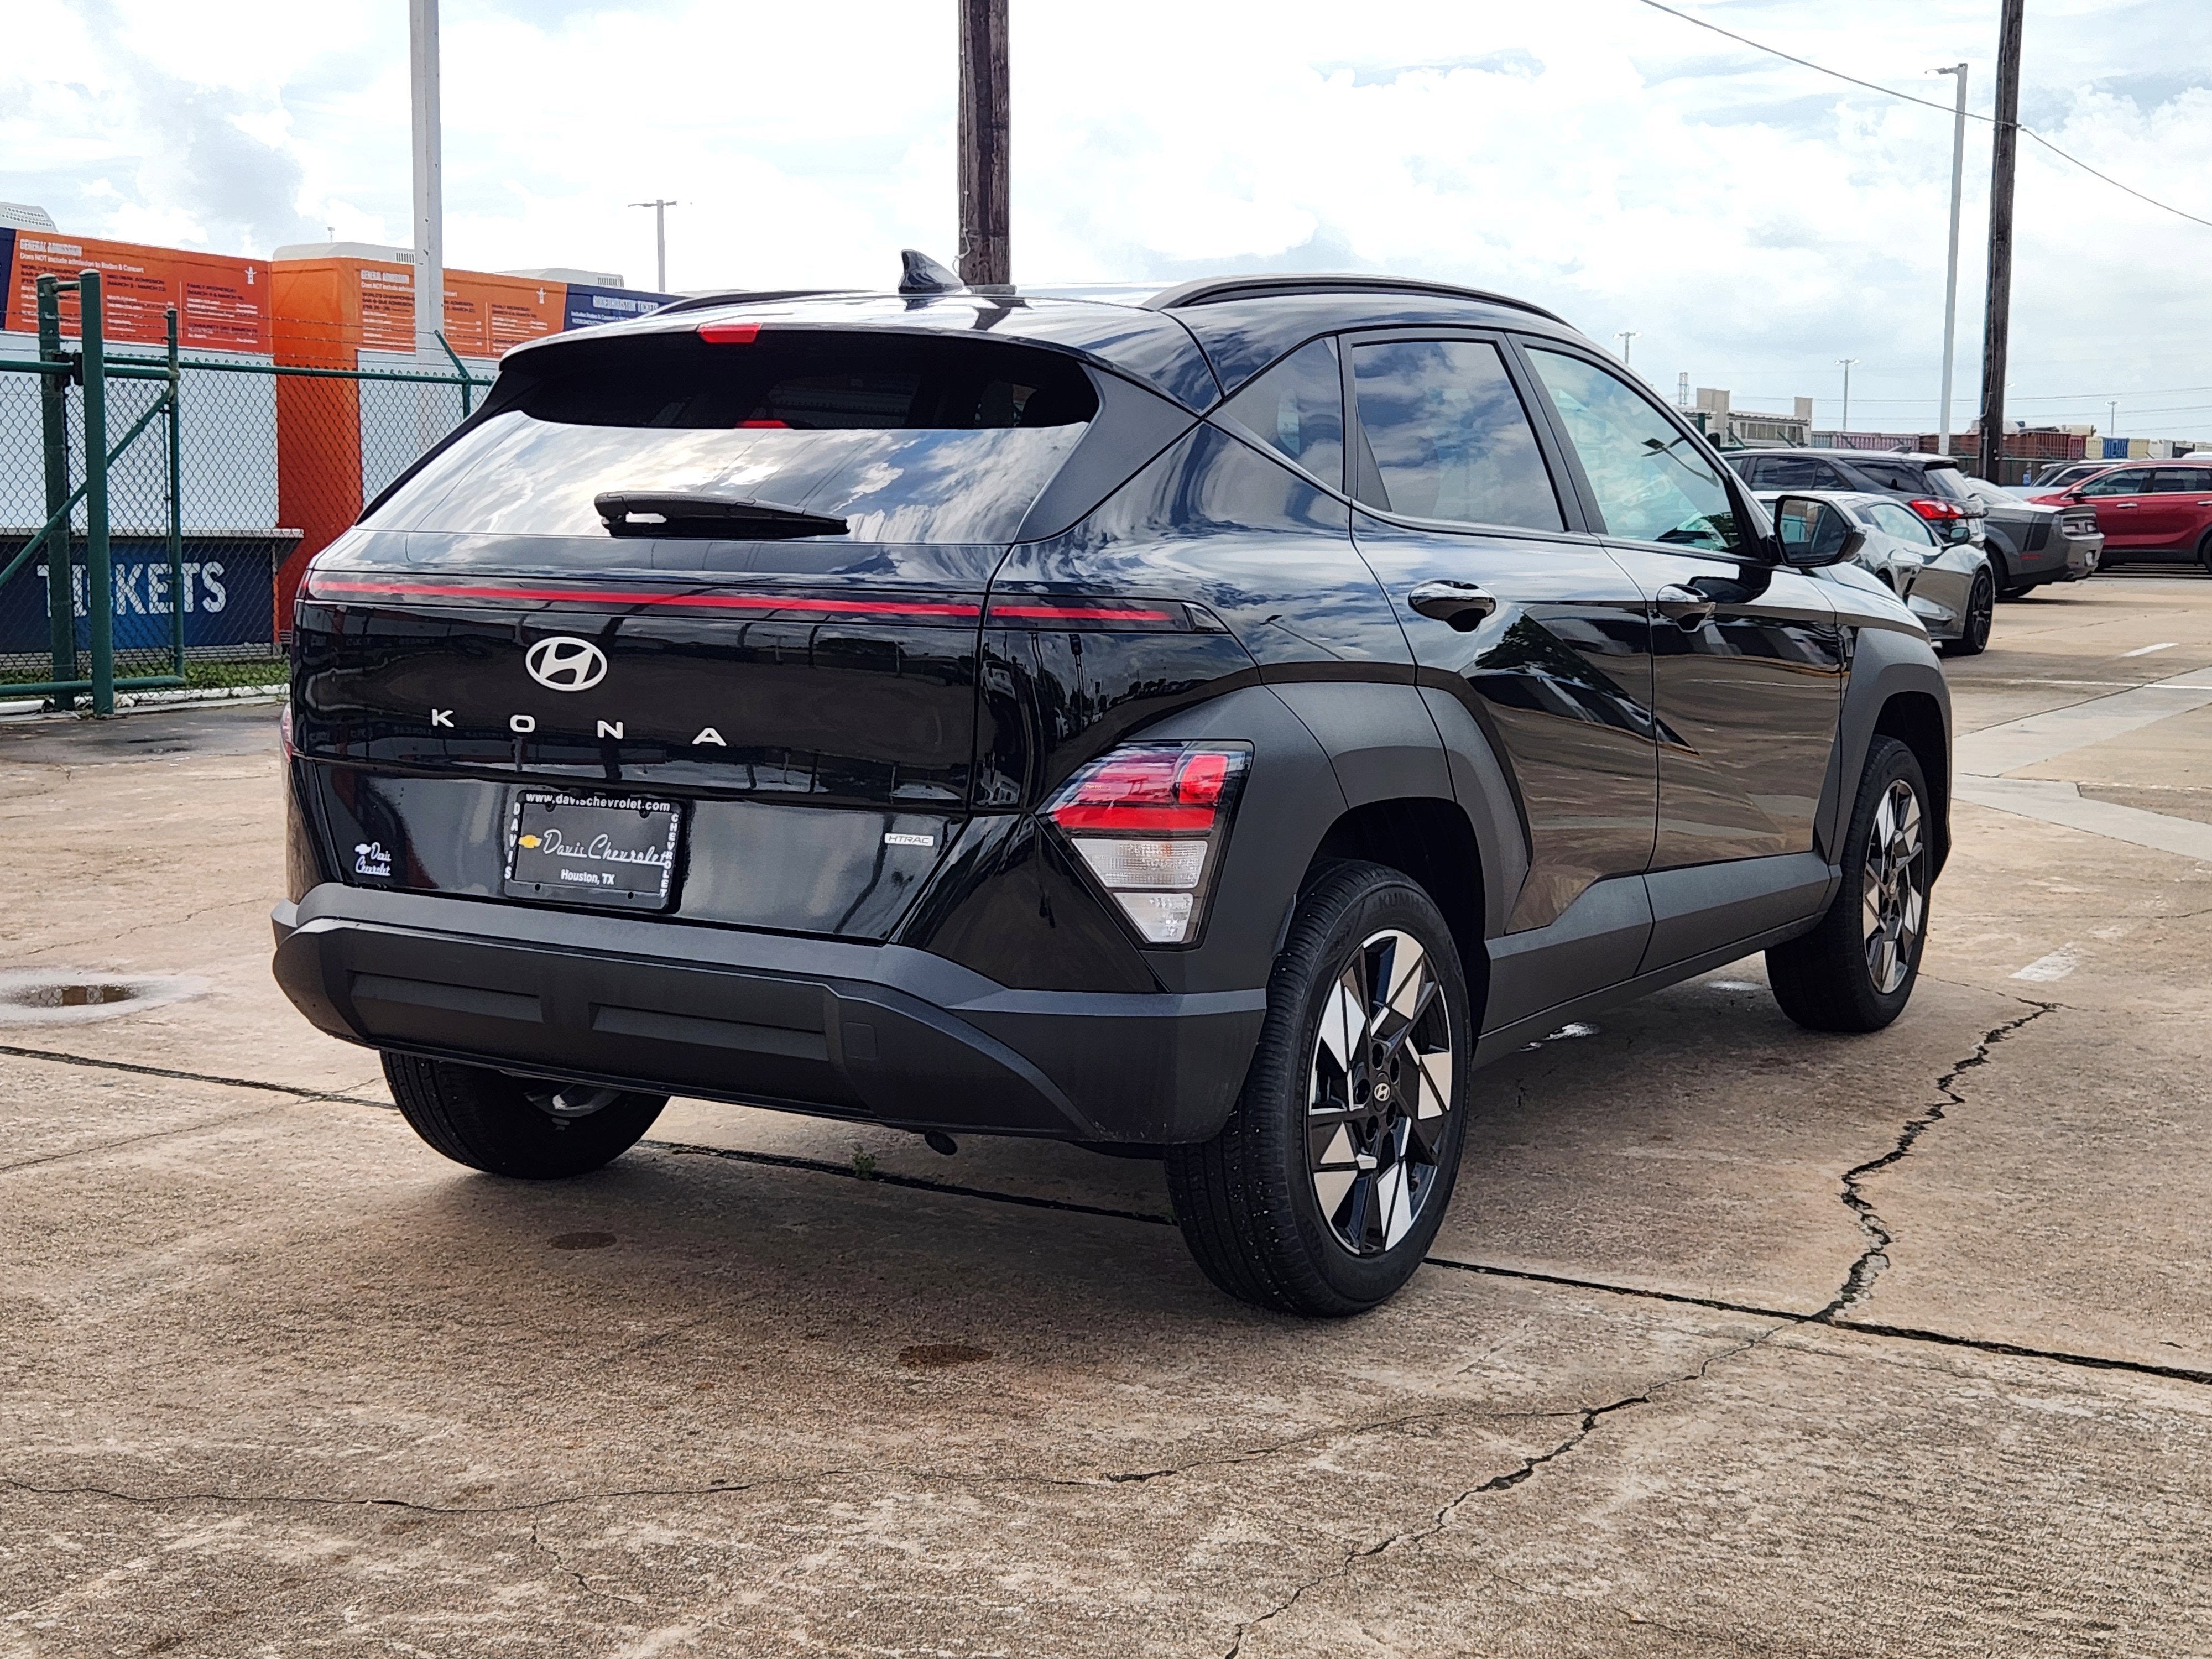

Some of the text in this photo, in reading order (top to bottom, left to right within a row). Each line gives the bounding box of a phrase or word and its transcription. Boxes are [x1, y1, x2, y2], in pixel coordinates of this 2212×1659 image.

[37, 561, 226, 617] TIKETS
[431, 708, 727, 747] KONA
[526, 792, 670, 811] www.davischevrolet.com
[504, 802, 520, 879] DAVIS
[543, 829, 667, 865] Davis Chevrolet
[660, 813, 679, 898] CHEVROLET
[889, 835, 930, 844] HTRAC
[560, 869, 615, 885] Houston, TX
